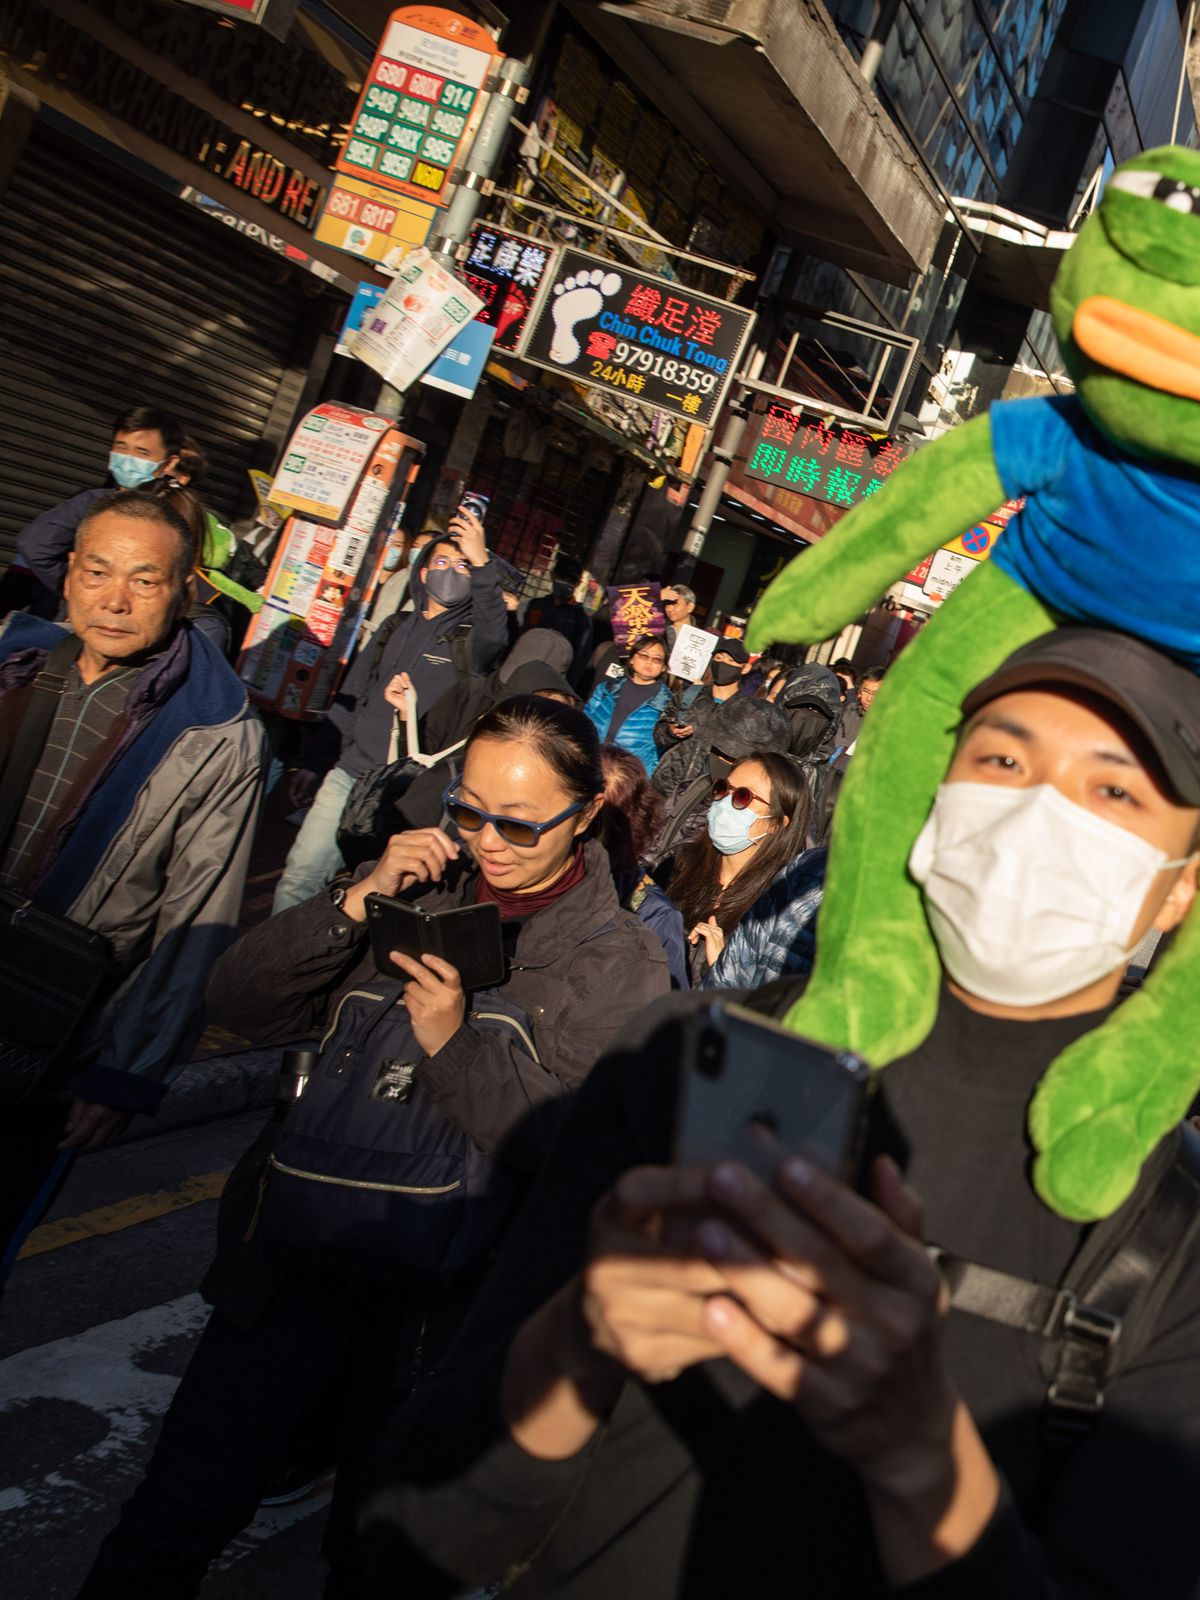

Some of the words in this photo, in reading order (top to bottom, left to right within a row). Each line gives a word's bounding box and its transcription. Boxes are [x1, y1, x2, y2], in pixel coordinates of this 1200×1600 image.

[365, 87, 398, 115] 948
[375, 61, 408, 89] 680
[441, 83, 473, 111] 914
[223, 139, 286, 205] AND
[421, 136, 456, 165] 985
[329, 194, 358, 218] 681
[360, 203, 396, 231] 681P
[599, 311, 638, 339] Chin
[639, 326, 683, 356] Chuk
[685, 341, 730, 375] Tong
[590, 361, 645, 394] 24小時
[613, 342, 719, 395] 97918359
